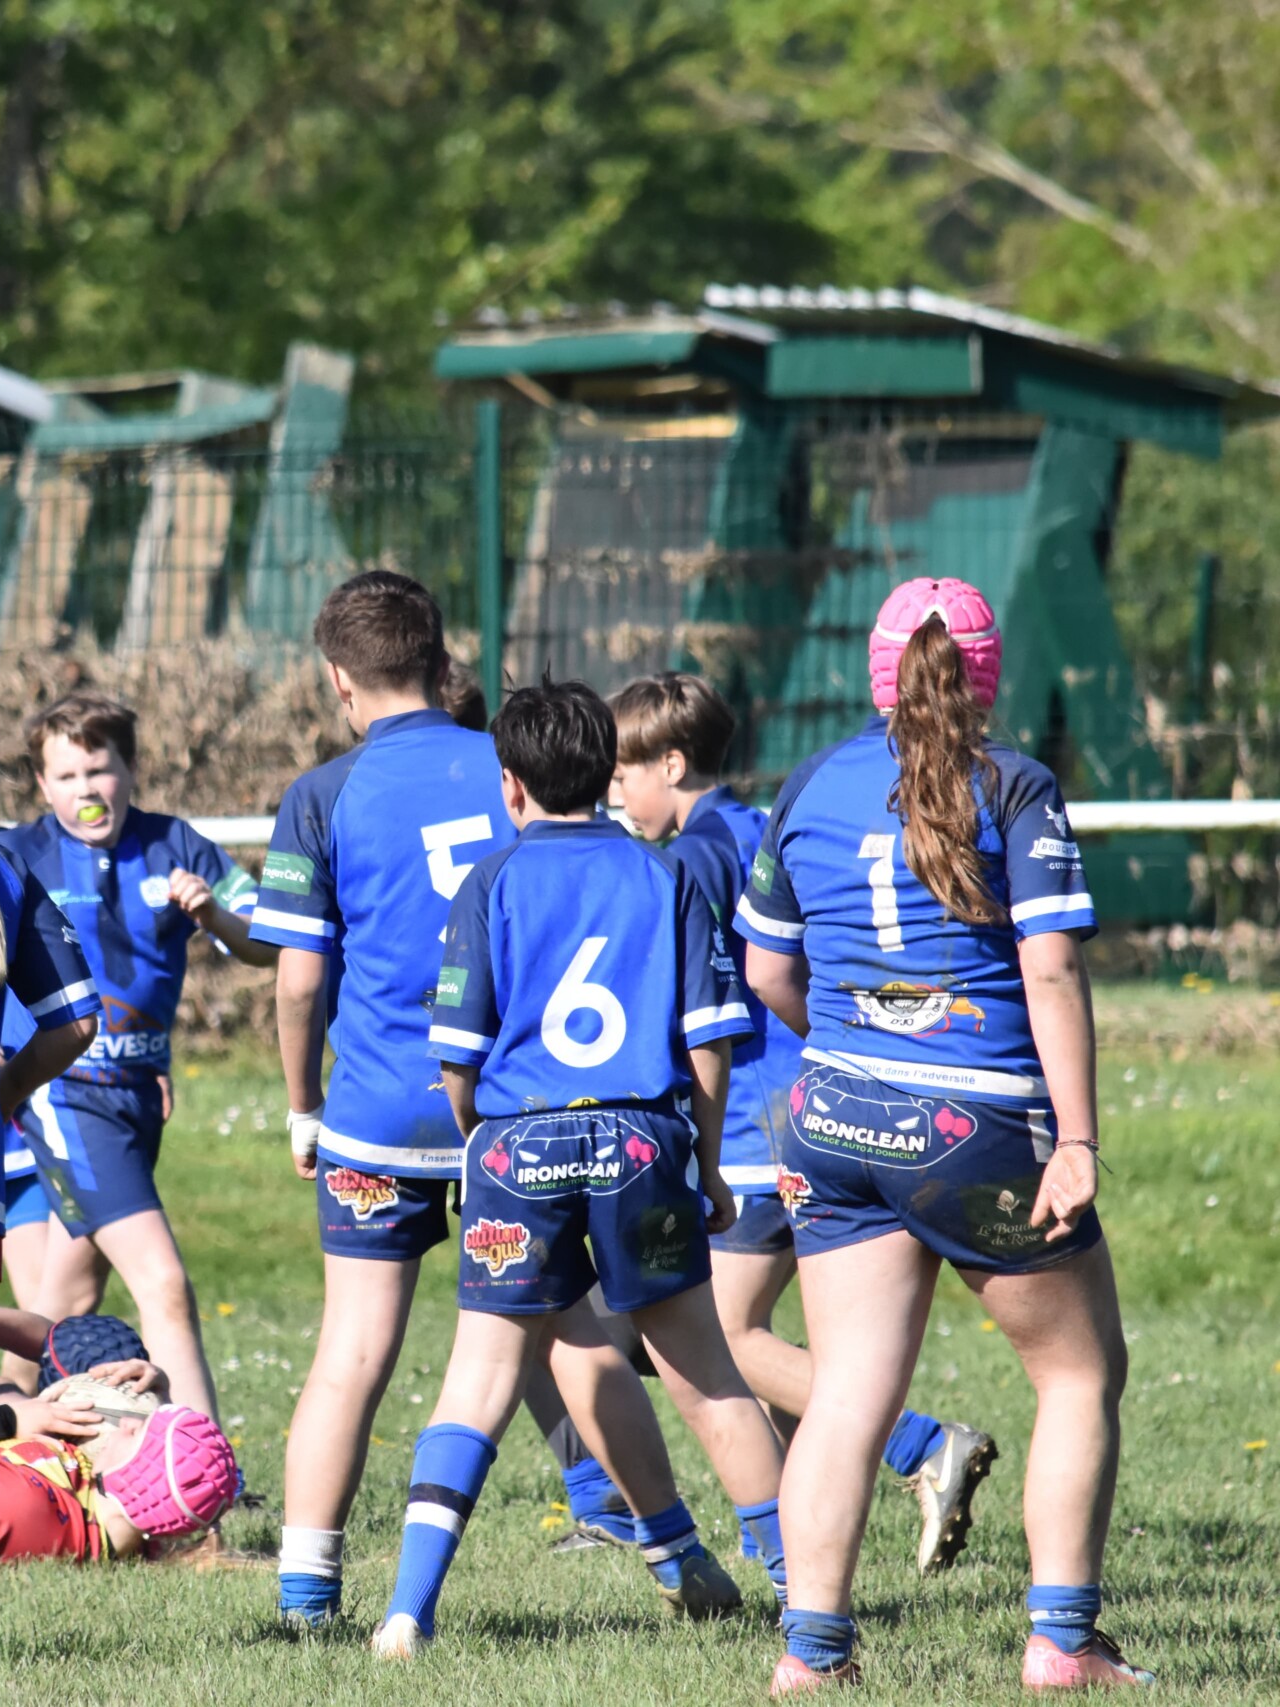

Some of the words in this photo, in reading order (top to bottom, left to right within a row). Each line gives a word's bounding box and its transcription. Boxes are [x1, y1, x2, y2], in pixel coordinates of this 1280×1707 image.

[857, 834, 905, 952] 1
[541, 937, 627, 1068] 6
[885, 1067, 909, 1077] dans
[914, 1067, 976, 1084] l'adversité
[803, 1114, 926, 1152] IRONCLEAN
[808, 1132, 839, 1146] LAVAGE
[842, 1141, 866, 1153] AUTO
[875, 1148, 918, 1160] DOMICILE
[421, 1154, 463, 1163] Ensemb
[357, 1187, 395, 1214] gus
[526, 1182, 557, 1191] LAVAGE
[466, 1220, 527, 1249] station
[488, 1240, 525, 1272] gus
